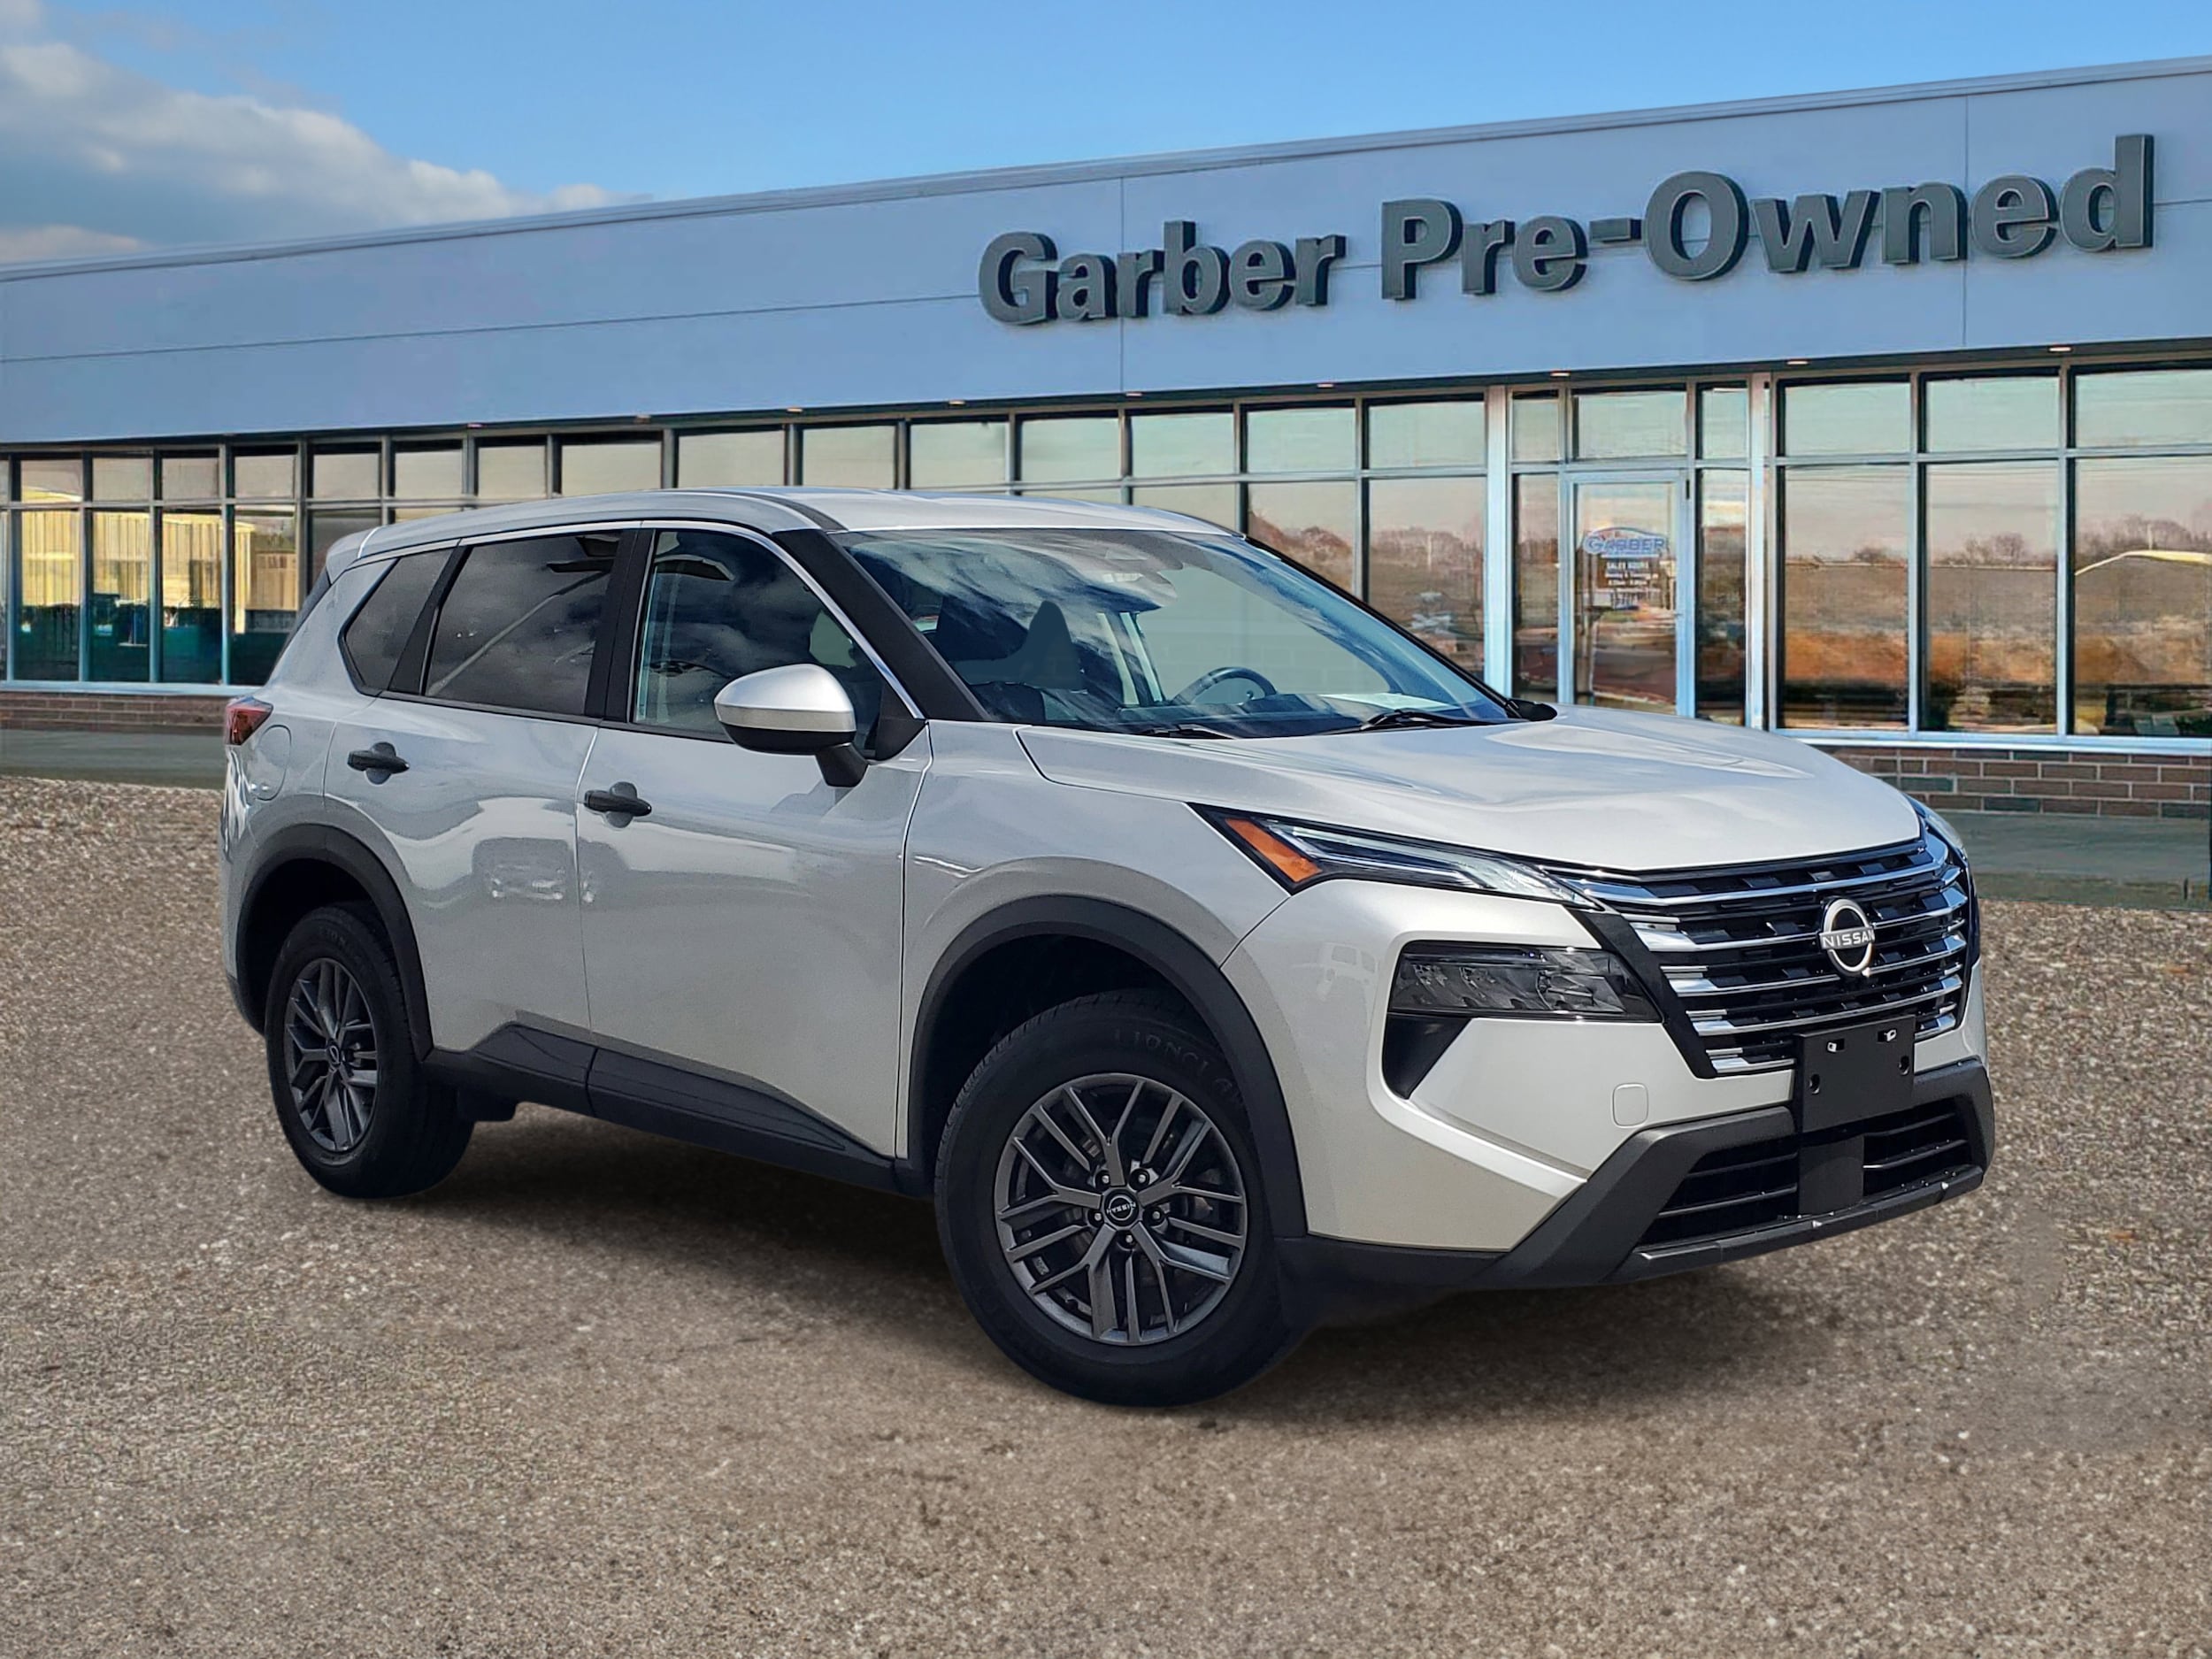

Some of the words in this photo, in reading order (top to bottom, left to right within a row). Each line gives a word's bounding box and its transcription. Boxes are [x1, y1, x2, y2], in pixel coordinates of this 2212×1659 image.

[979, 219, 1347, 325] Garber
[1381, 134, 2155, 301] Pre-Owned
[1587, 536, 1664, 550] GARBER
[1822, 929, 1875, 949] NISSAN
